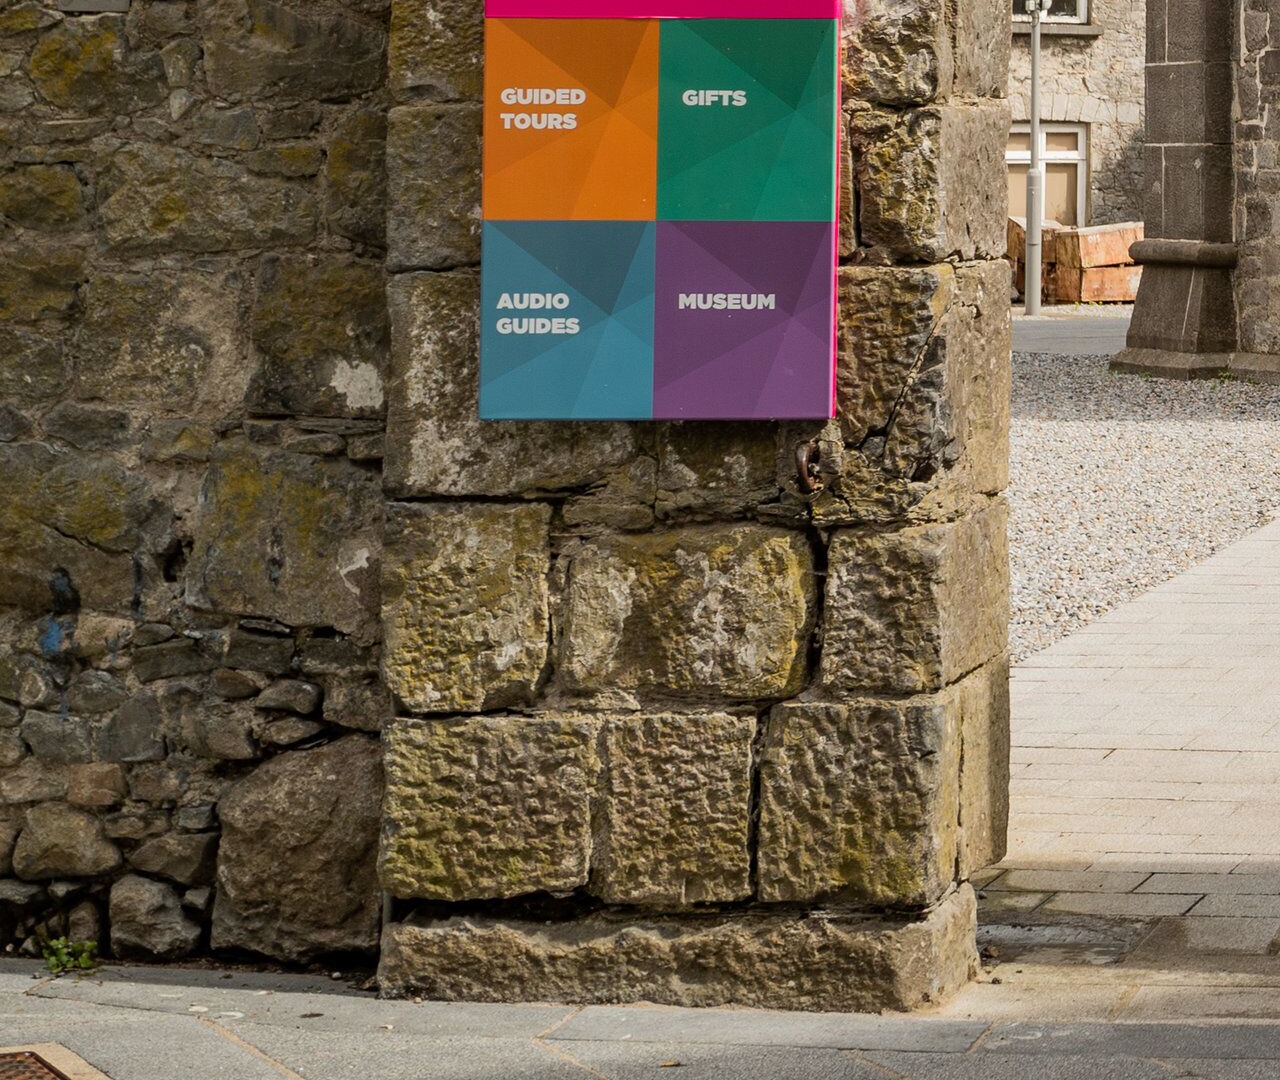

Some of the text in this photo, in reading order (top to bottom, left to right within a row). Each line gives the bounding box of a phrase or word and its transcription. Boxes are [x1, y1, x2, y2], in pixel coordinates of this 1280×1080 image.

[500, 87, 587, 106] GUIDED
[681, 89, 748, 108] GIFTS
[500, 112, 578, 131] TOURS
[496, 292, 571, 311] AUDIO
[678, 293, 777, 311] MUSEUM
[495, 317, 581, 336] GUIDES
